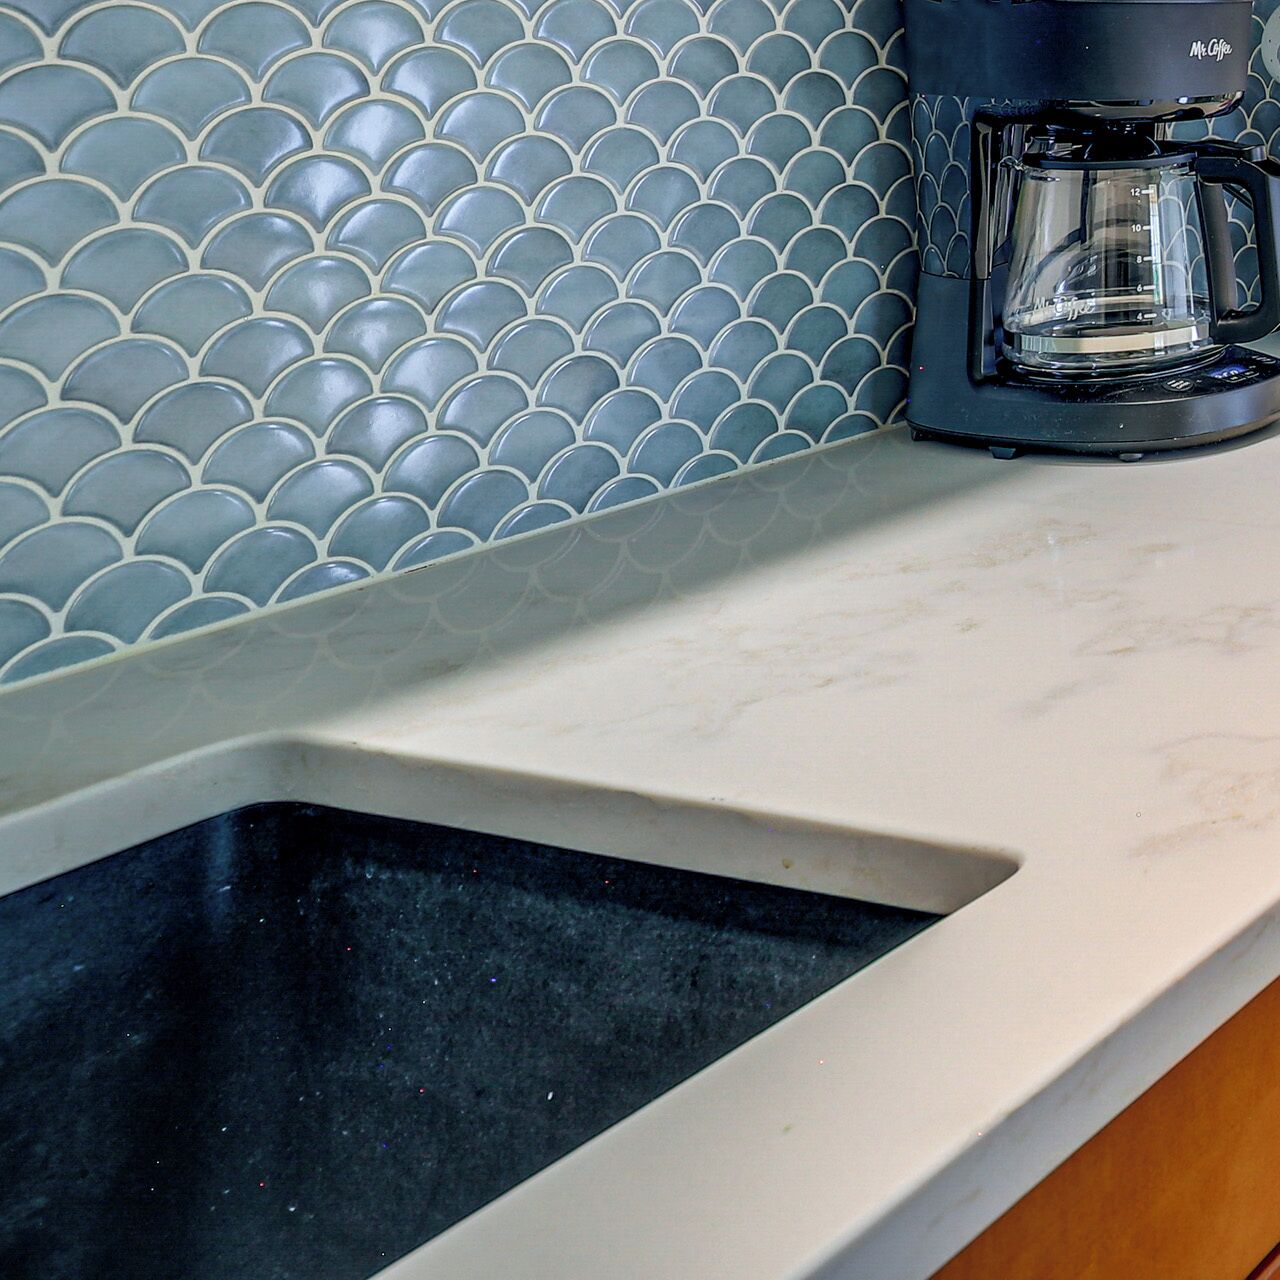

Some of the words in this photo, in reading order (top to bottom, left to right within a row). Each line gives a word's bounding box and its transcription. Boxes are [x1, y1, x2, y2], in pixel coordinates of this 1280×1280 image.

[1208, 38, 1233, 62] Coffee
[1130, 188, 1140, 196] 12
[1131, 224, 1141, 232] 10
[1136, 284, 1142, 292] 6
[1136, 312, 1142, 320] 4
